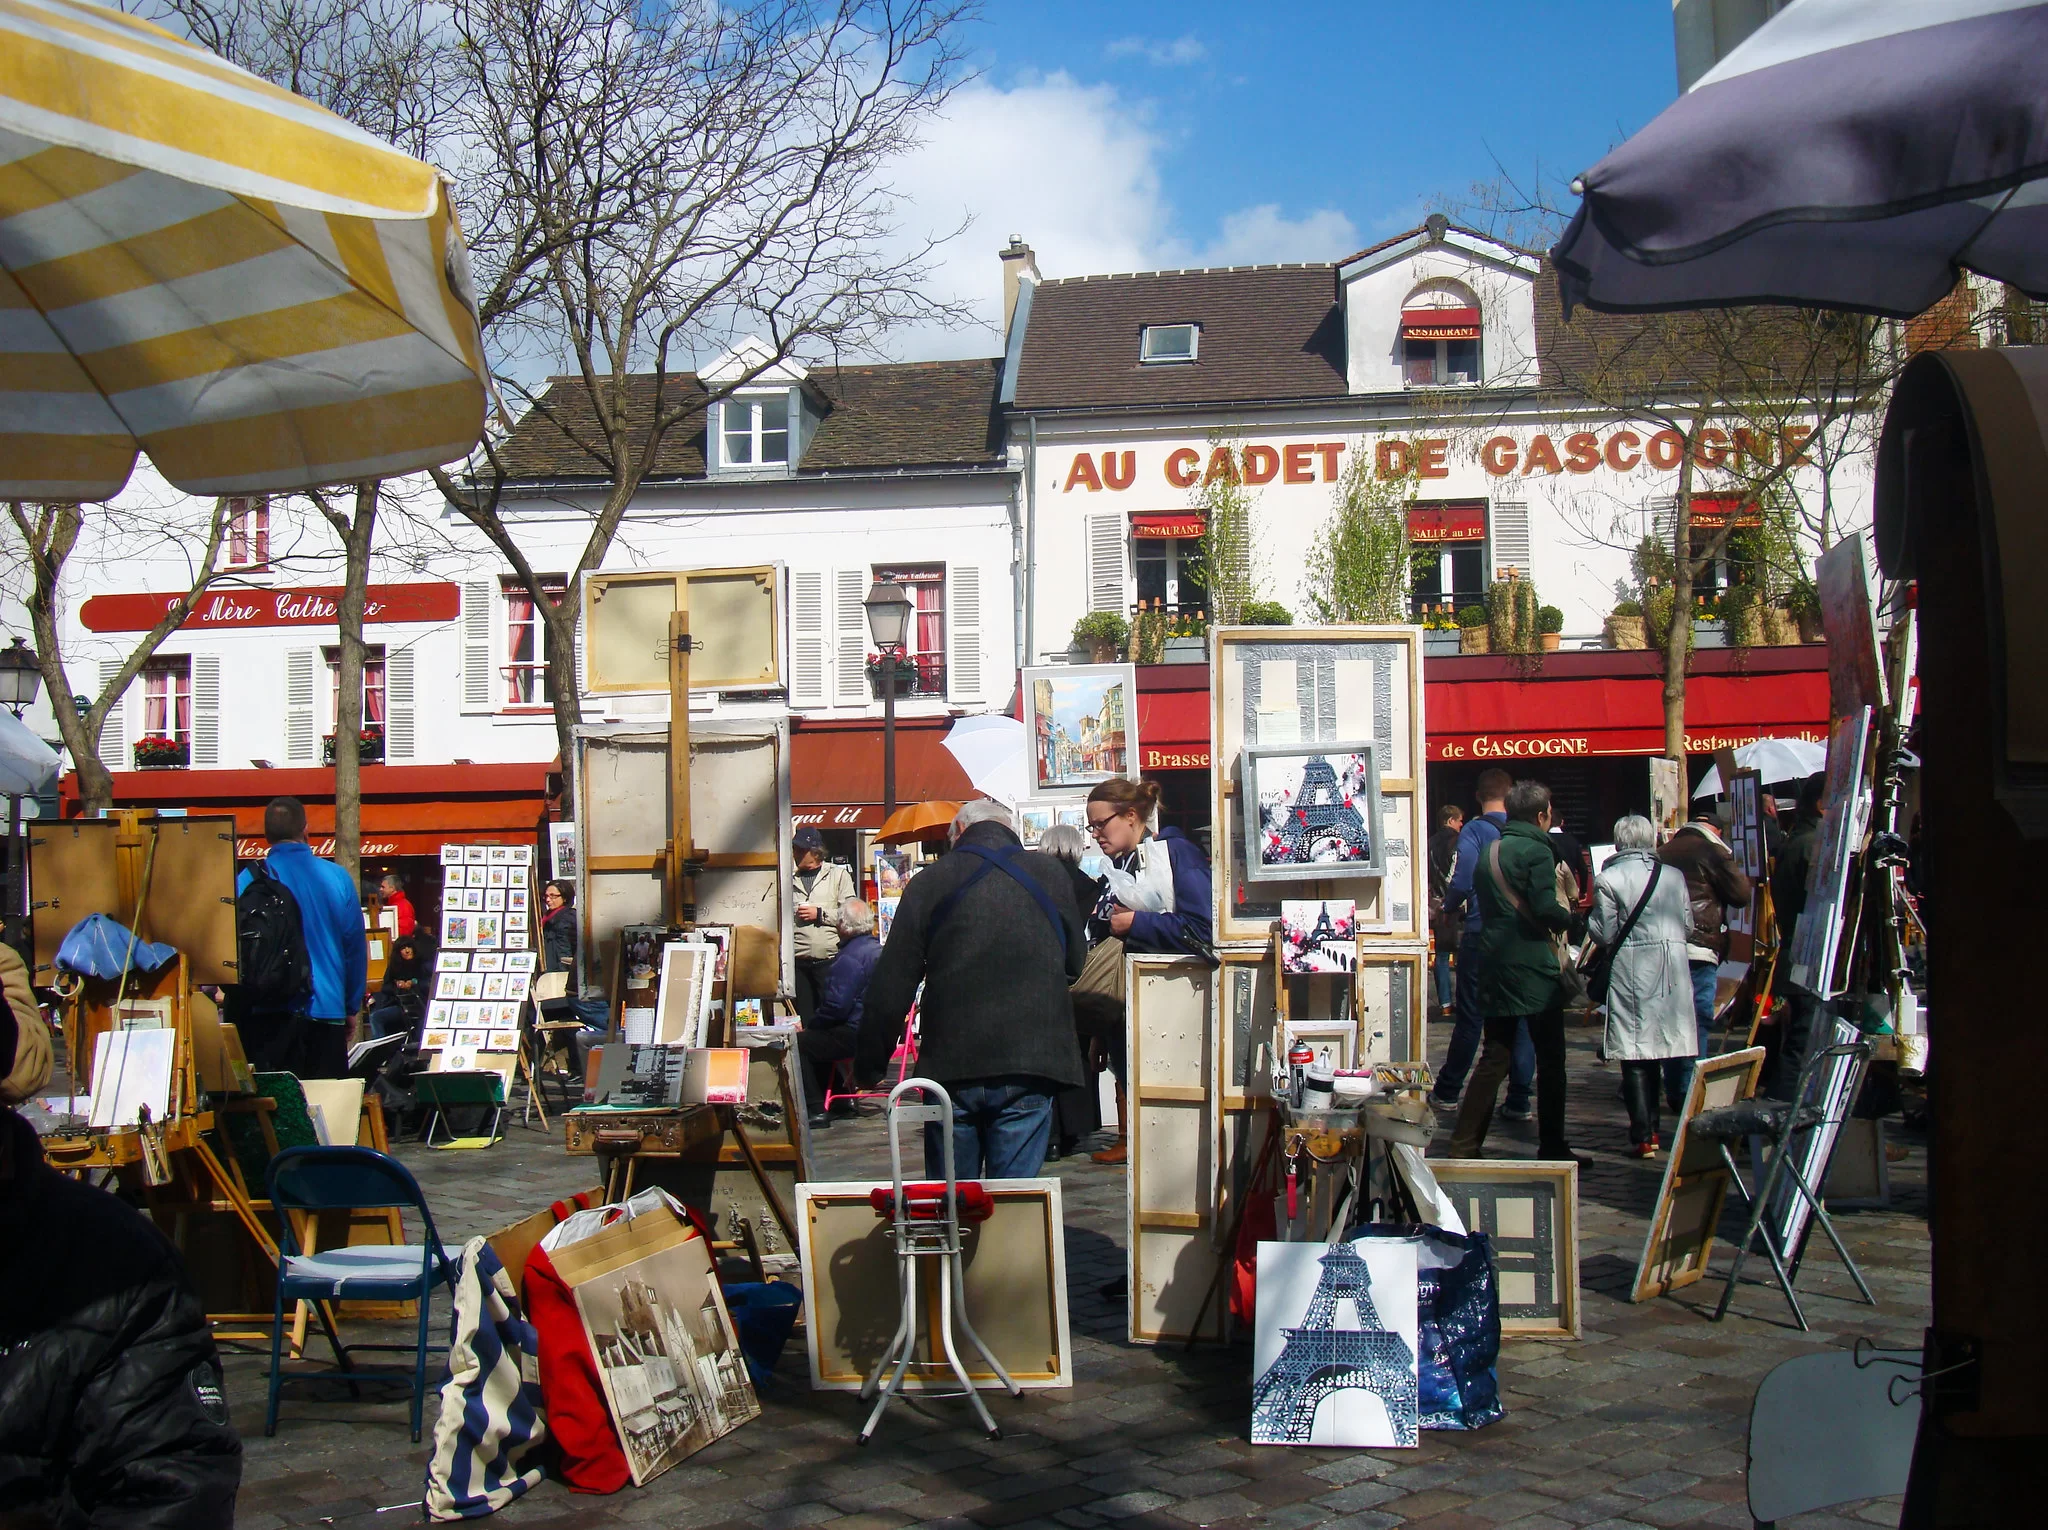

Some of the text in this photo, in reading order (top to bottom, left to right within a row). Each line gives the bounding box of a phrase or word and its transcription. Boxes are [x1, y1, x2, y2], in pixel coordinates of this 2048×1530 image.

[1408, 327, 1473, 337] RESTAURANT
[1062, 425, 1812, 493] AU CADET DE GASCOGNE
[1413, 528, 1448, 539] SALLE
[1467, 527, 1482, 537] 1er
[202, 594, 261, 621] Mère
[1441, 742, 1465, 758] de
[1472, 736, 1588, 757] GASCOGNE
[1147, 750, 1210, 767] Brasse
[834, 806, 863, 824] lit
